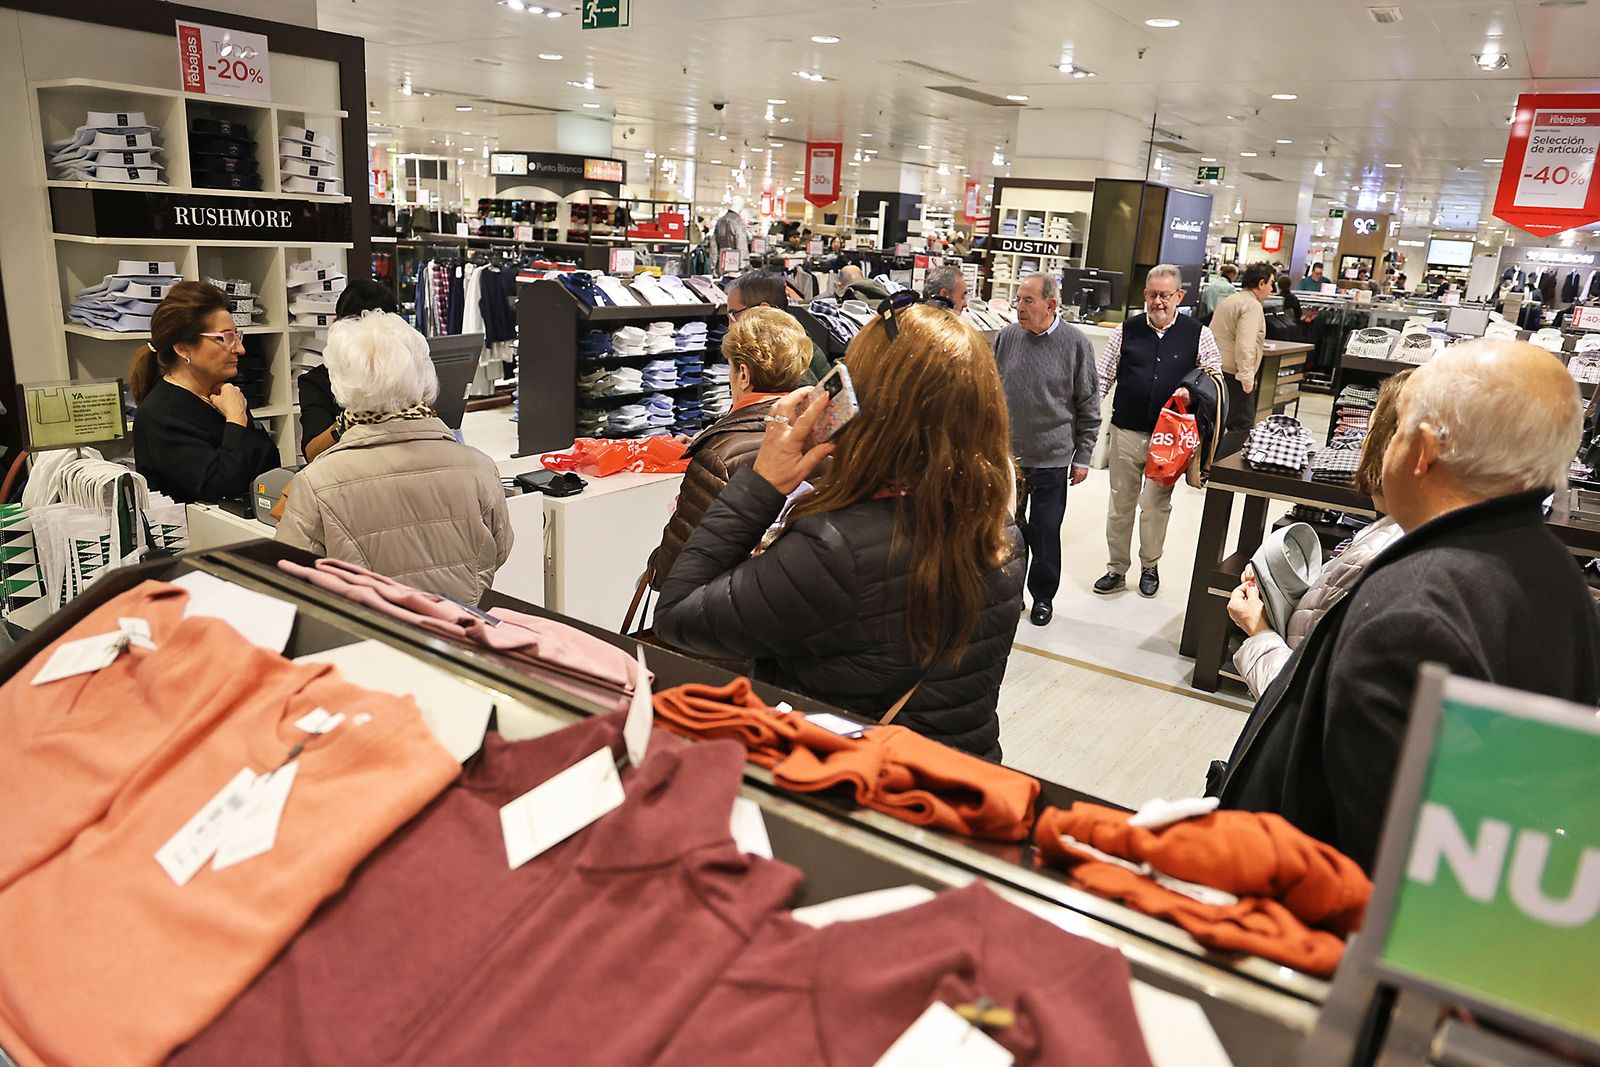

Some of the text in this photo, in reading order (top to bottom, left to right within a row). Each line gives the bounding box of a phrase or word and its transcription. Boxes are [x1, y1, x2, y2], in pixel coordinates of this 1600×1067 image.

[207, 58, 263, 84] -20%
[1550, 114, 1587, 126] rebajas
[1533, 135, 1585, 145] Selección
[1530, 144, 1594, 154] de artículos
[536, 162, 583, 174] Punto Blanco
[1523, 166, 1585, 186] -40%
[174, 206, 292, 228] RUSHMORE
[1002, 240, 1060, 255] DUSTIN
[72, 392, 84, 400] YA
[1405, 799, 1600, 928] NU
